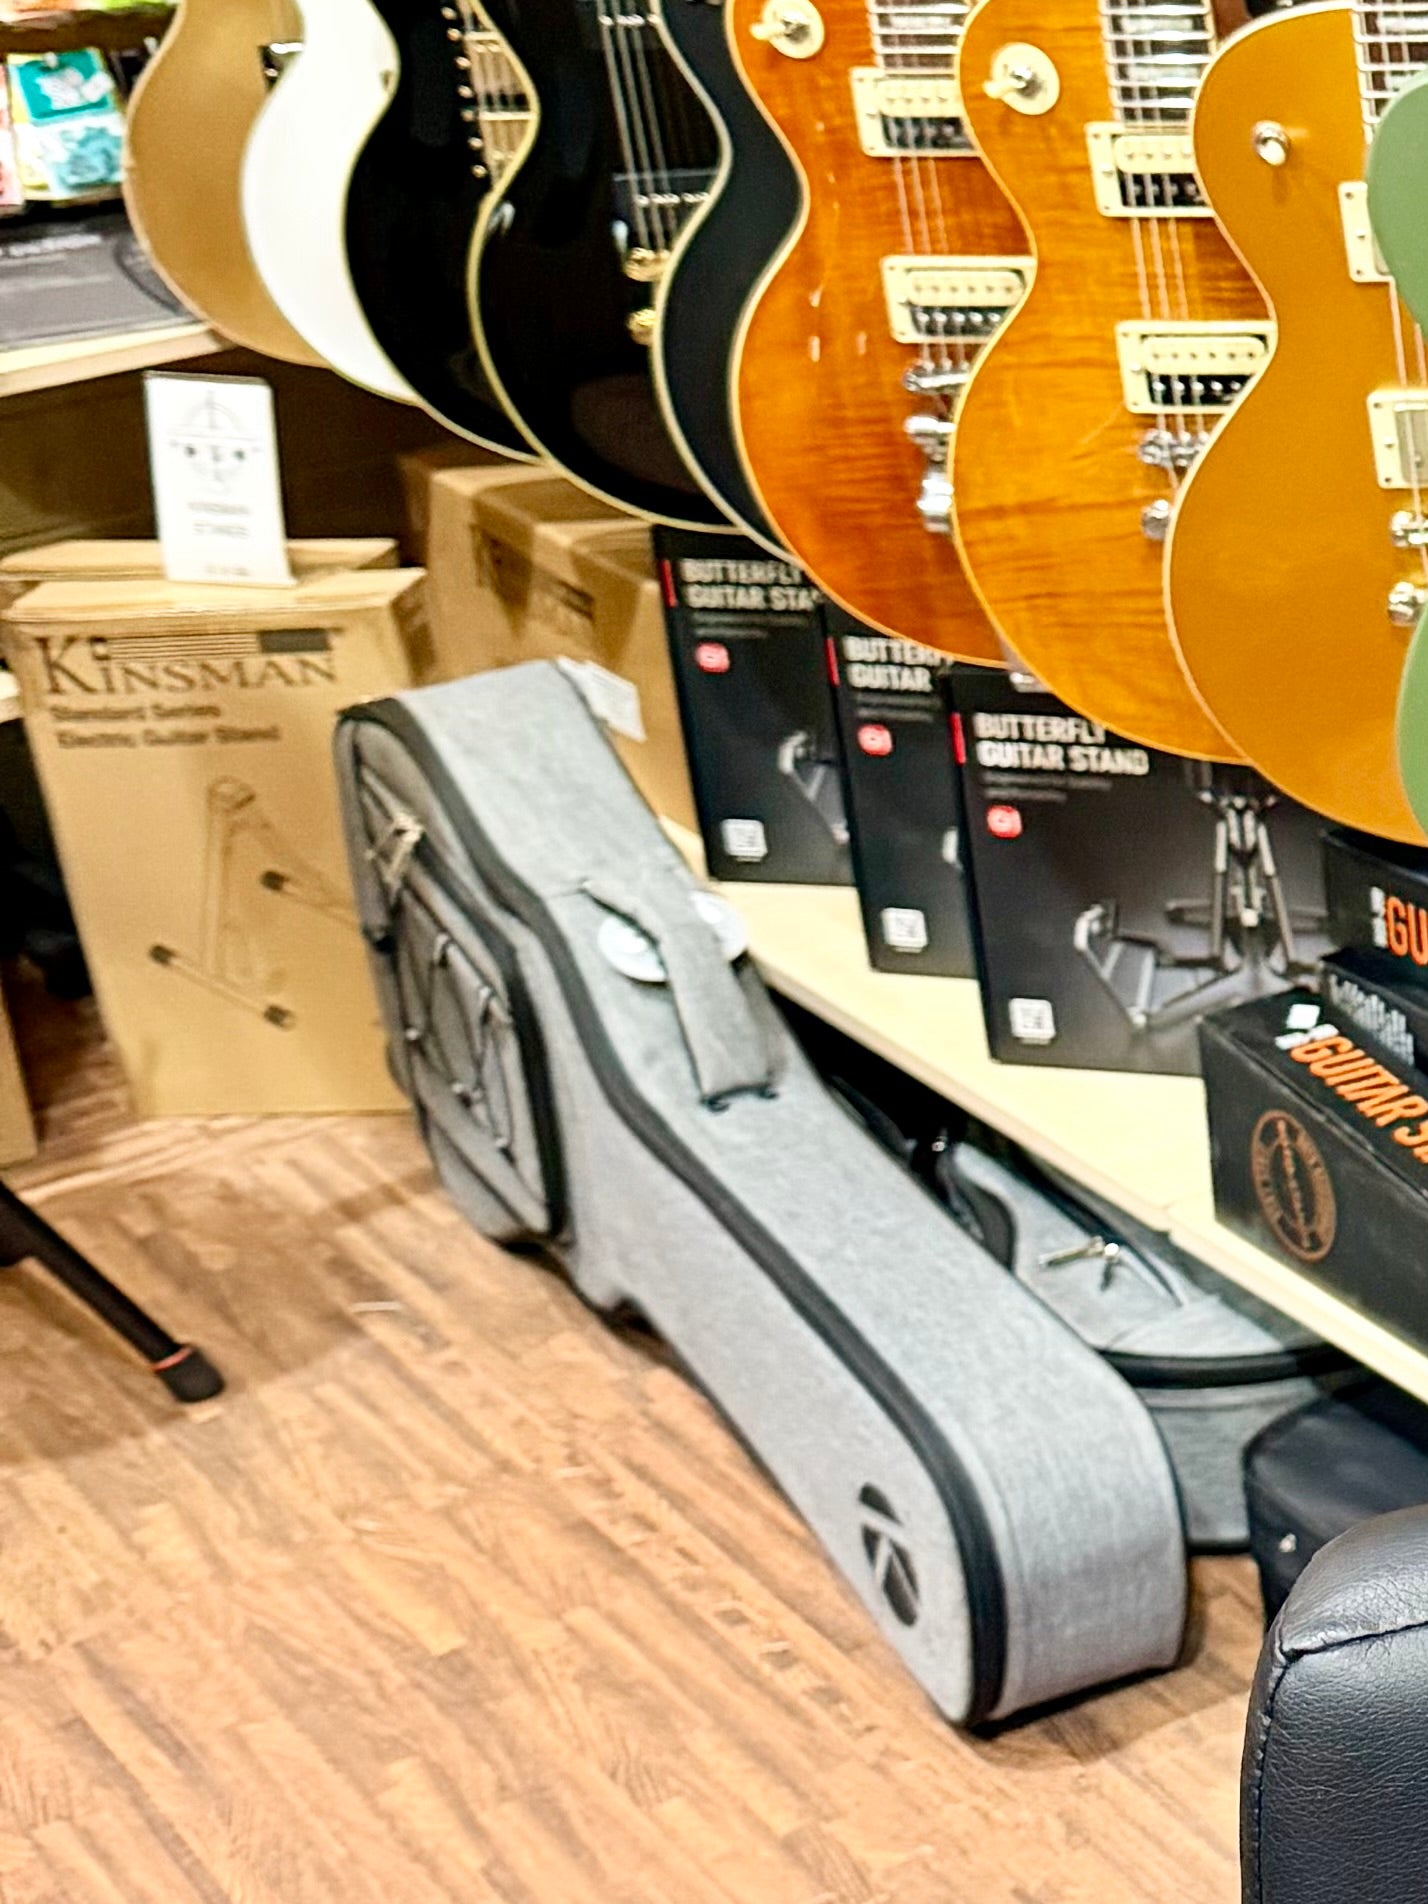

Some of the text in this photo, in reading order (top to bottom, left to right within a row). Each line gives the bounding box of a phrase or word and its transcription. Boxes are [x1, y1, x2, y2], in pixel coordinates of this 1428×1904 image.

[685, 584, 767, 608] GUITAR
[849, 664, 933, 692] GUITAR
[976, 741, 1149, 775] GUITAR STAND
